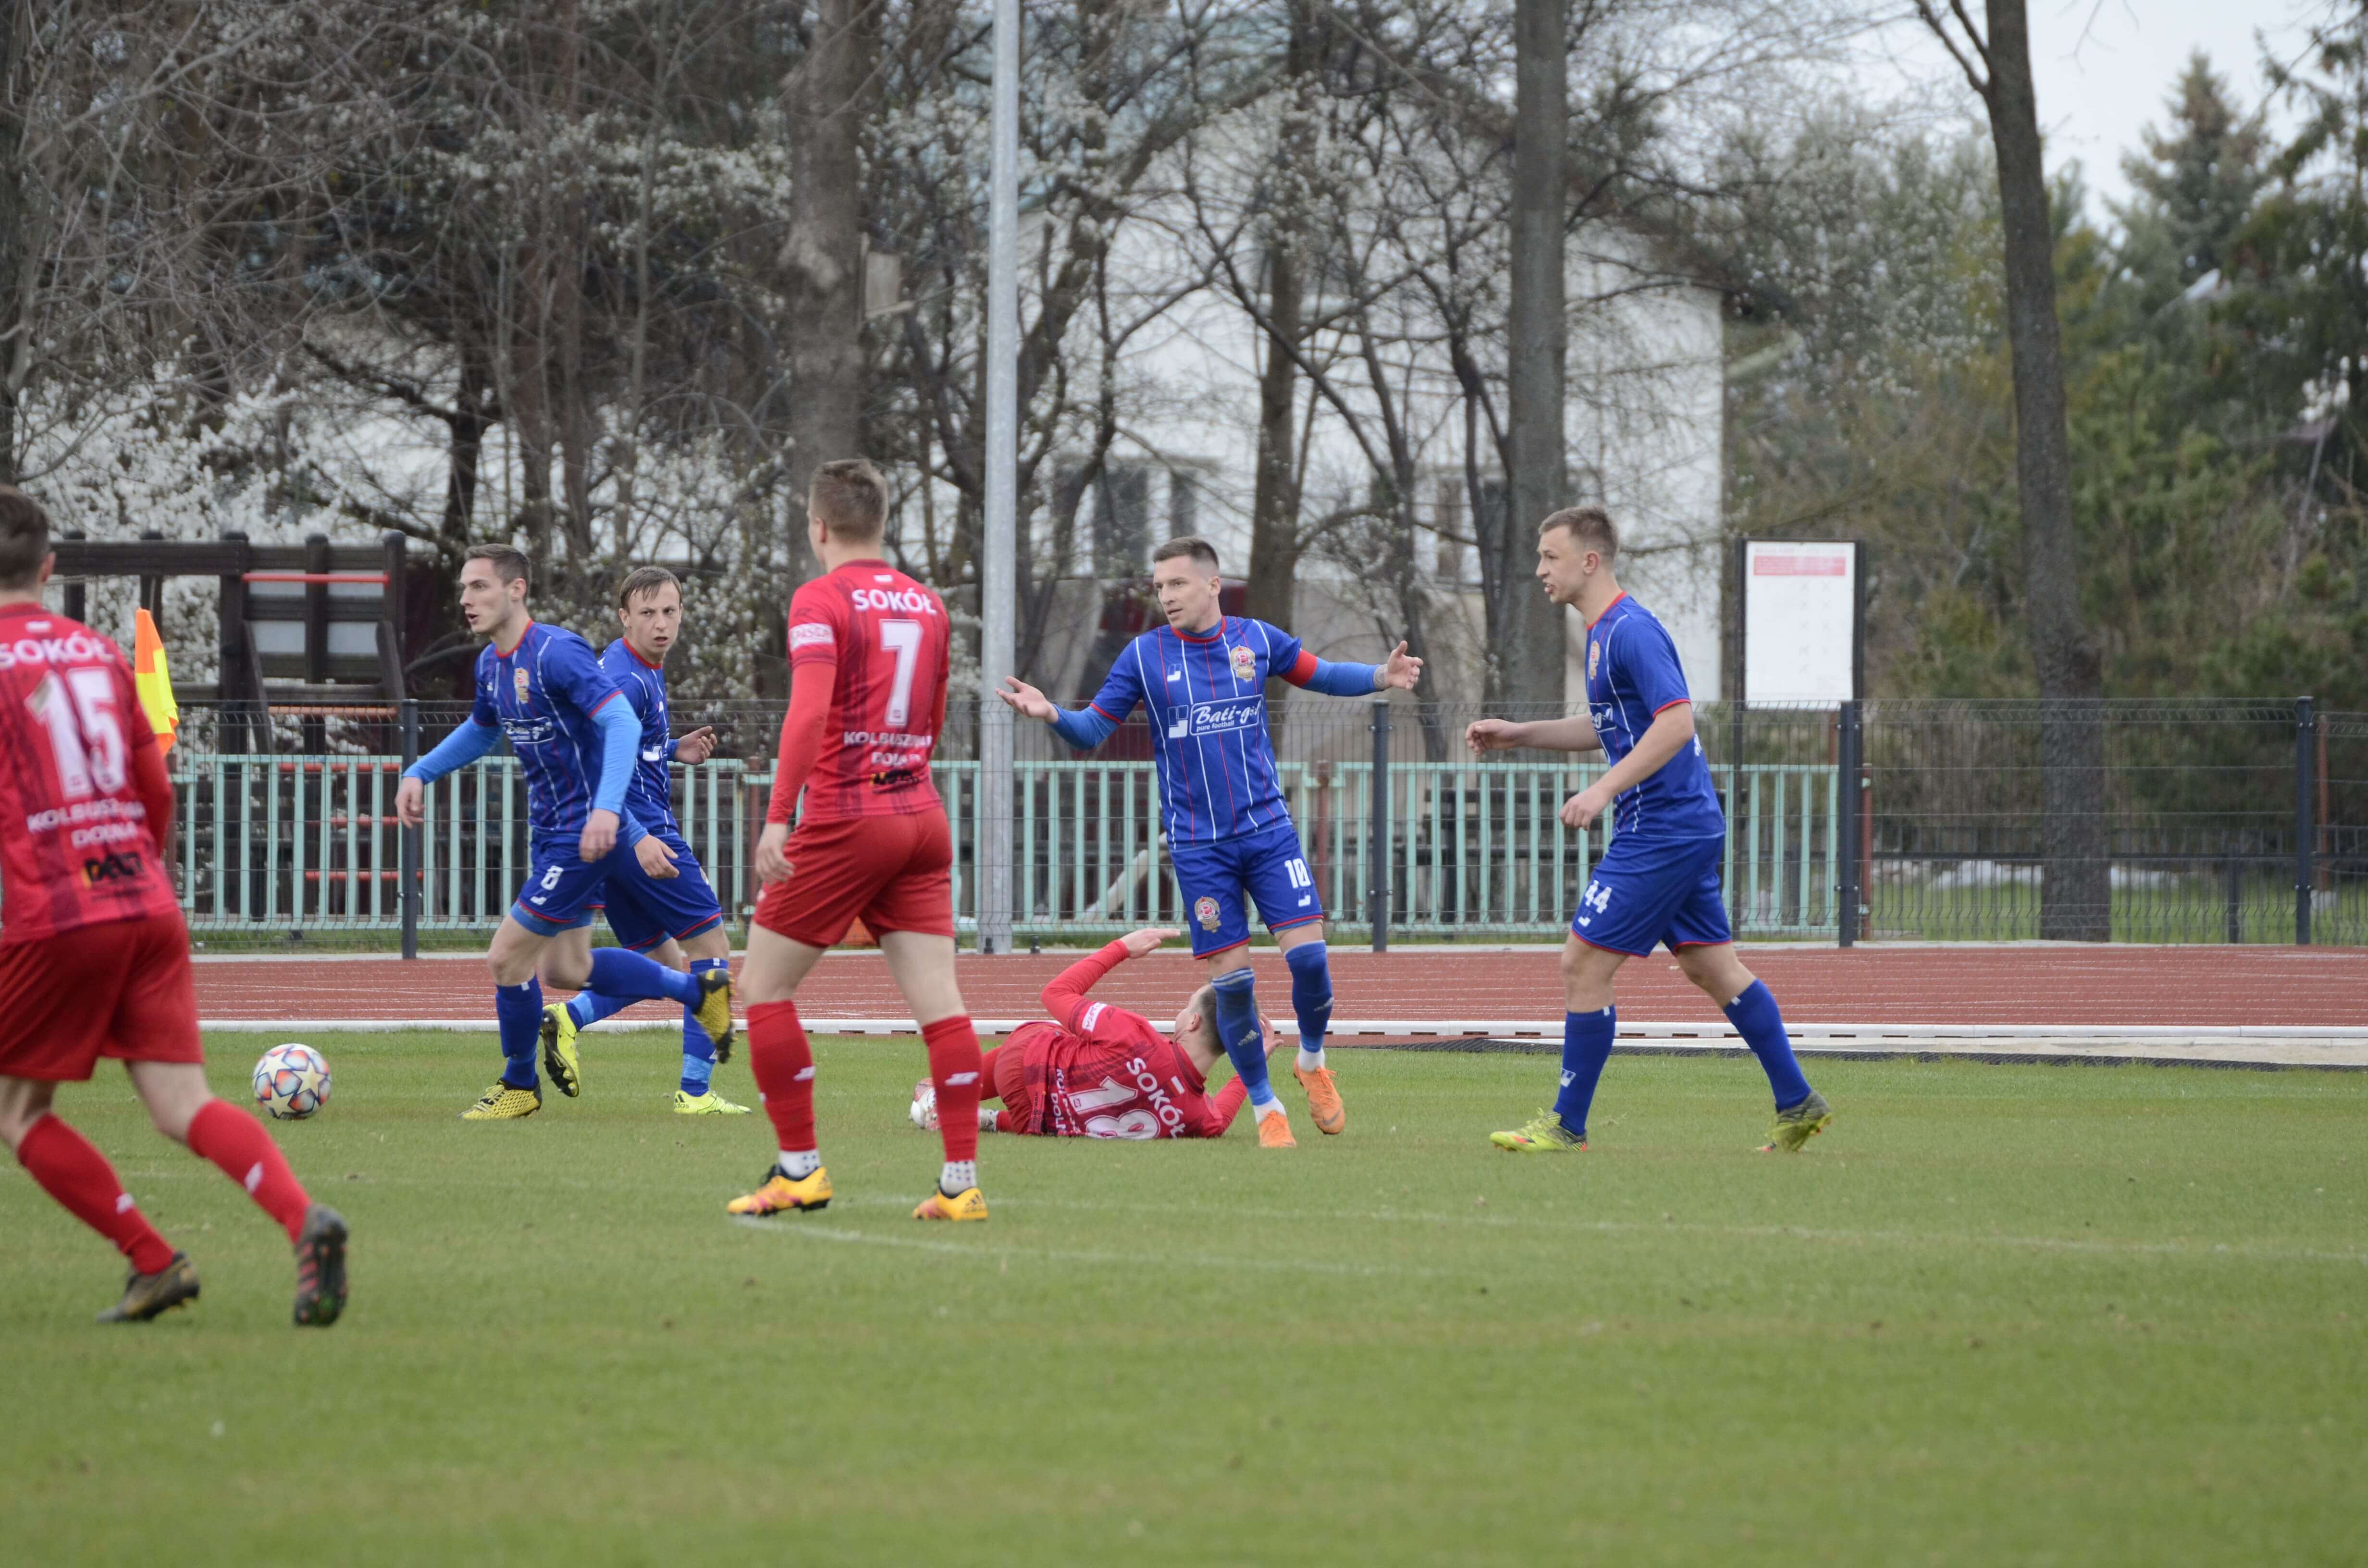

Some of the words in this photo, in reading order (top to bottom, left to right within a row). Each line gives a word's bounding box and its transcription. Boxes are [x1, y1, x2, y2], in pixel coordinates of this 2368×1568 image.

[851, 588, 937, 615] SOKÓŁ
[0, 631, 114, 668] SOKÓŁ
[878, 618, 924, 727] 7
[24, 666, 128, 801] 15
[541, 865, 564, 890] 8
[1284, 858, 1311, 889] 10
